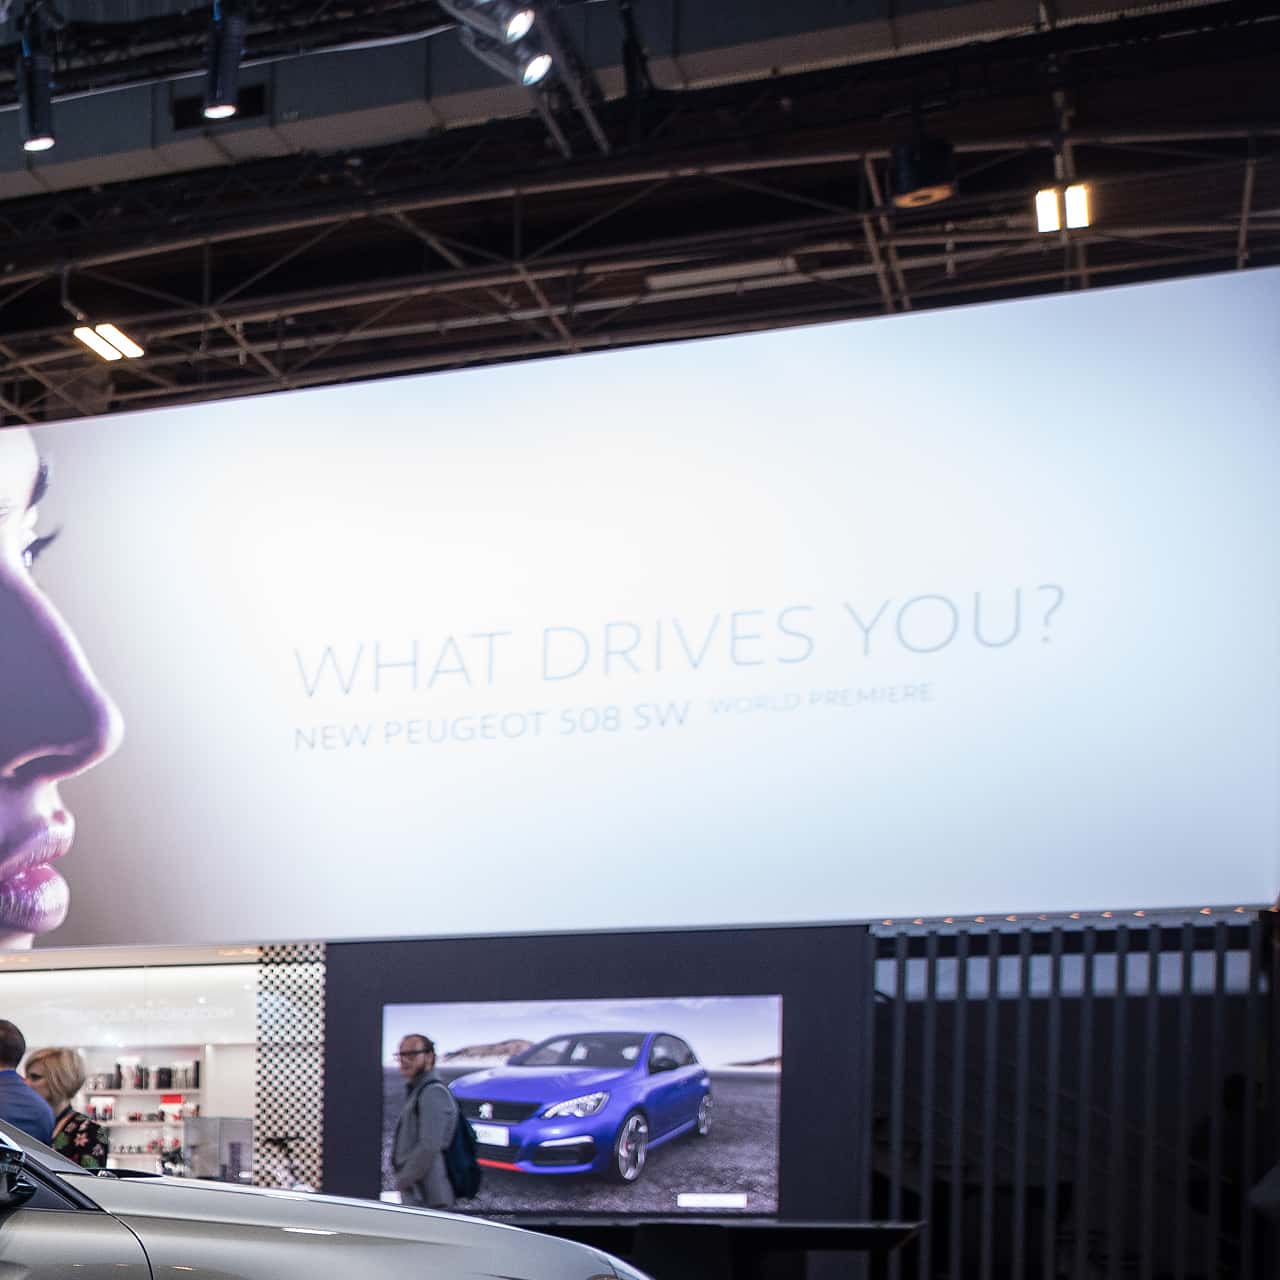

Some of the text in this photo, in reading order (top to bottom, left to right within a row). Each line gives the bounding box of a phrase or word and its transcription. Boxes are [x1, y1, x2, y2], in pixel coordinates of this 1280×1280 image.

[292, 583, 1065, 699] WHAT DRIVES YOU?
[293, 681, 936, 753] NEW PEUGEOT 508 SW WORLD PREMIERE
